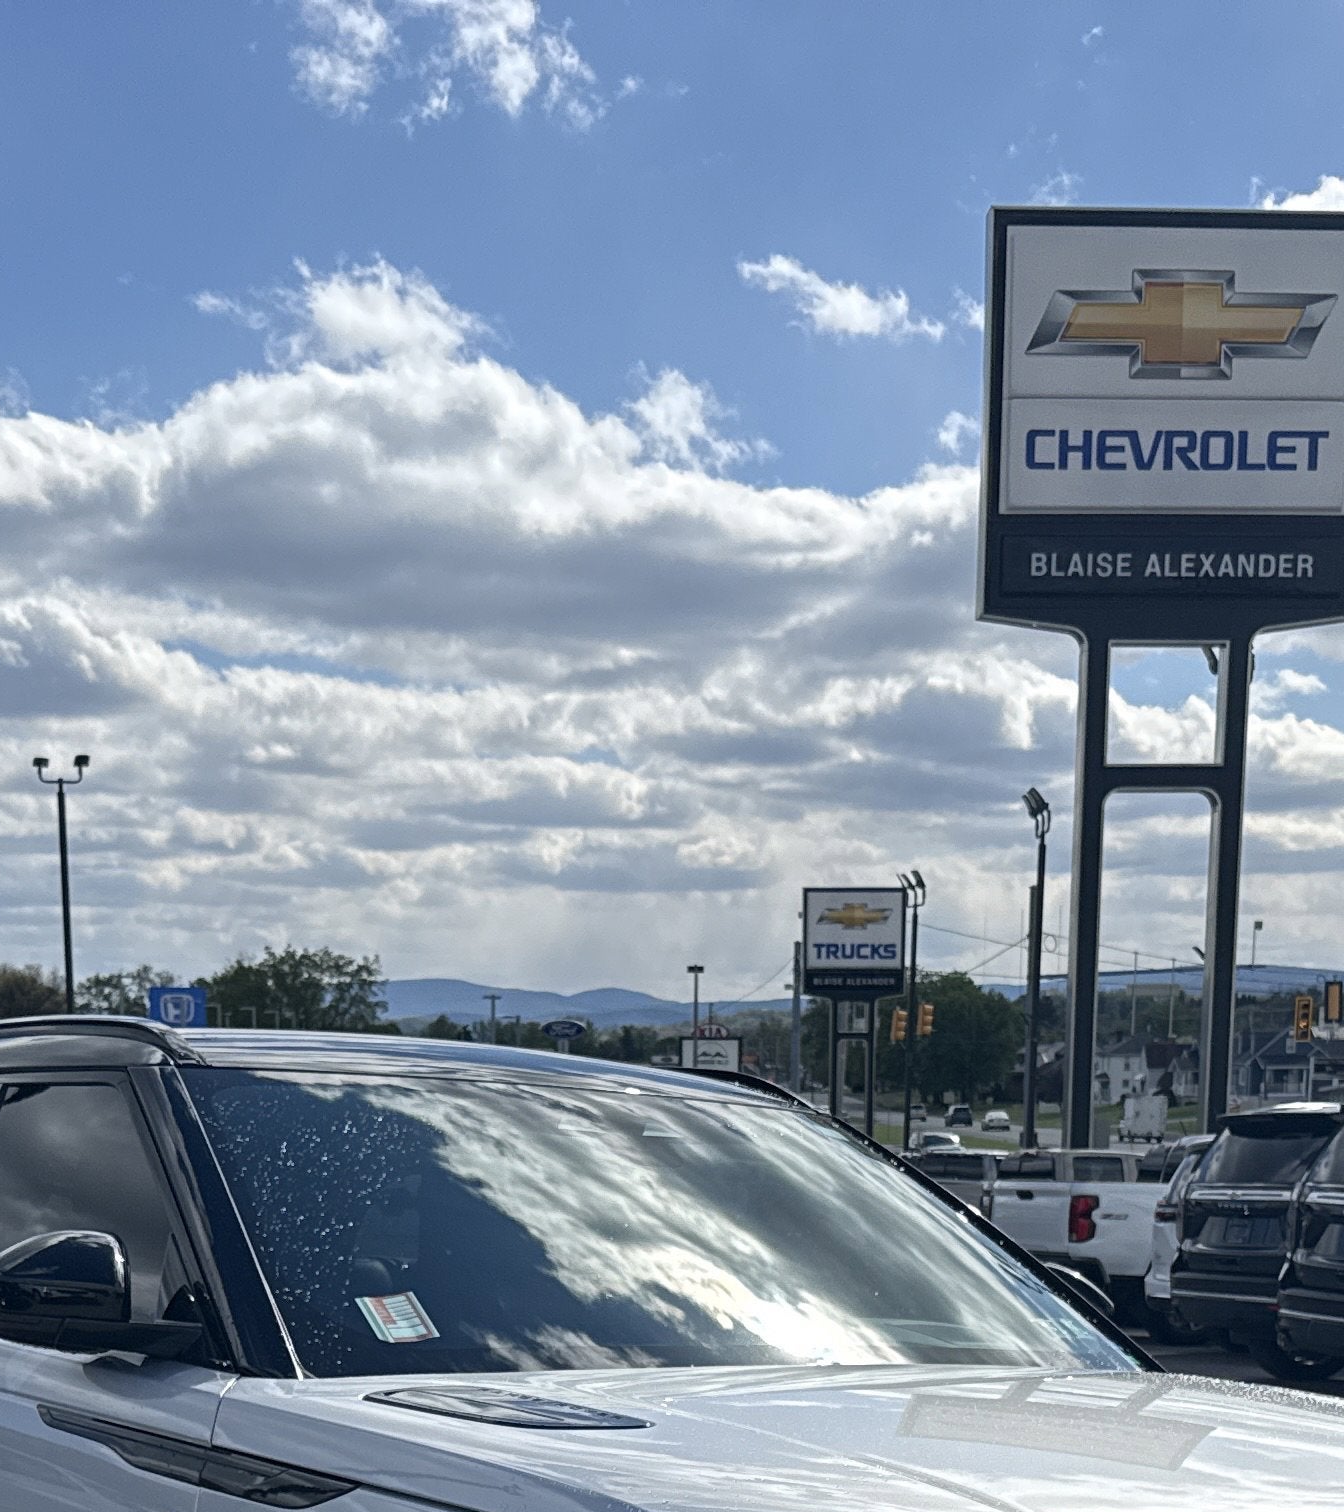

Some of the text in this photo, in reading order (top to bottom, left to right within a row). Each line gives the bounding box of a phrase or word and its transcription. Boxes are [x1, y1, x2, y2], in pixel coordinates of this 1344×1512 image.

[1025, 429, 1329, 472] CHEVROLET
[1030, 553, 1314, 578] BLAISE ALEXANDER
[813, 944, 897, 960] TRUCKS
